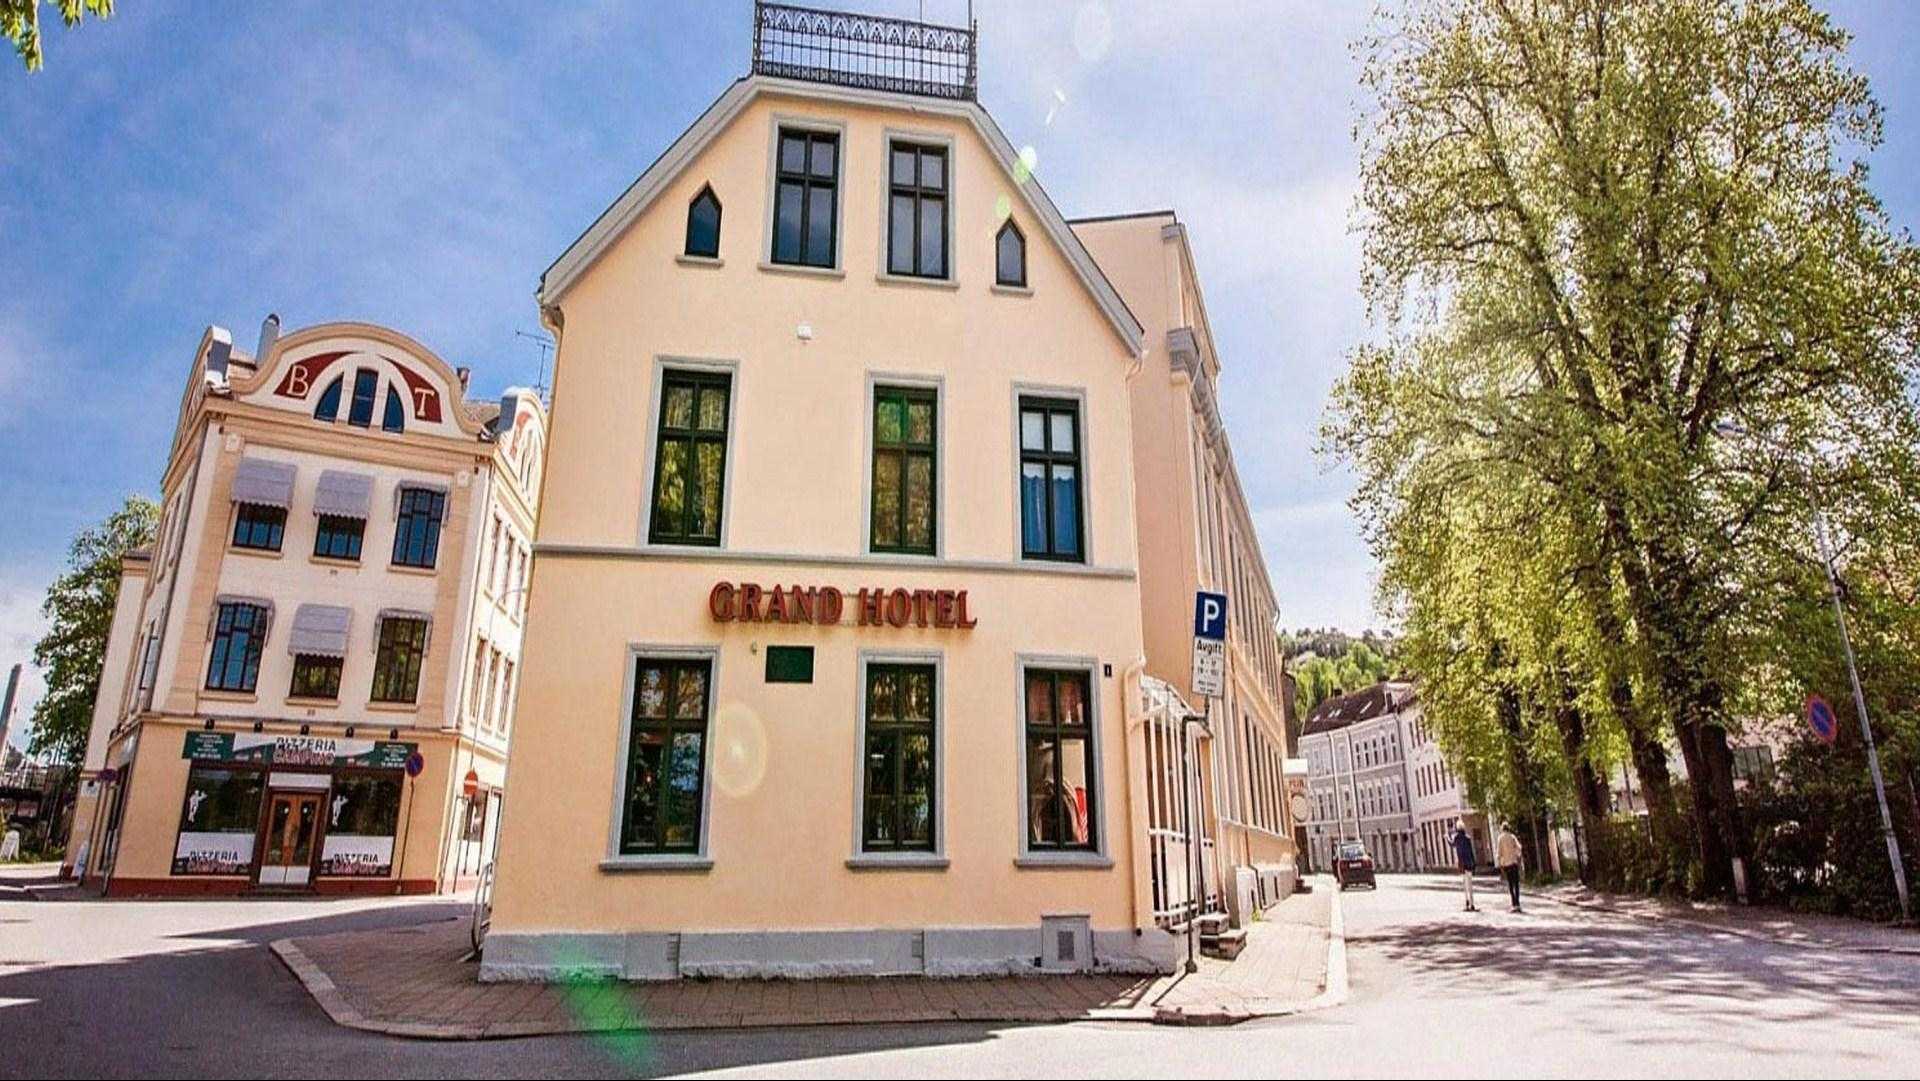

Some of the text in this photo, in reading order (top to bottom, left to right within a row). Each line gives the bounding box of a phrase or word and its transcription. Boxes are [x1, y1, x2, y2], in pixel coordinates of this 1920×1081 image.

[286, 365, 435, 416] B T
[709, 581, 978, 630] GRAND HOTEL
[1203, 599, 1220, 633] P
[1196, 639, 1222, 655] Avgift
[275, 736, 336, 751] PIZZERIA
[188, 850, 238, 861] PIZZERIA
[333, 852, 379, 864] PIZZERIA
